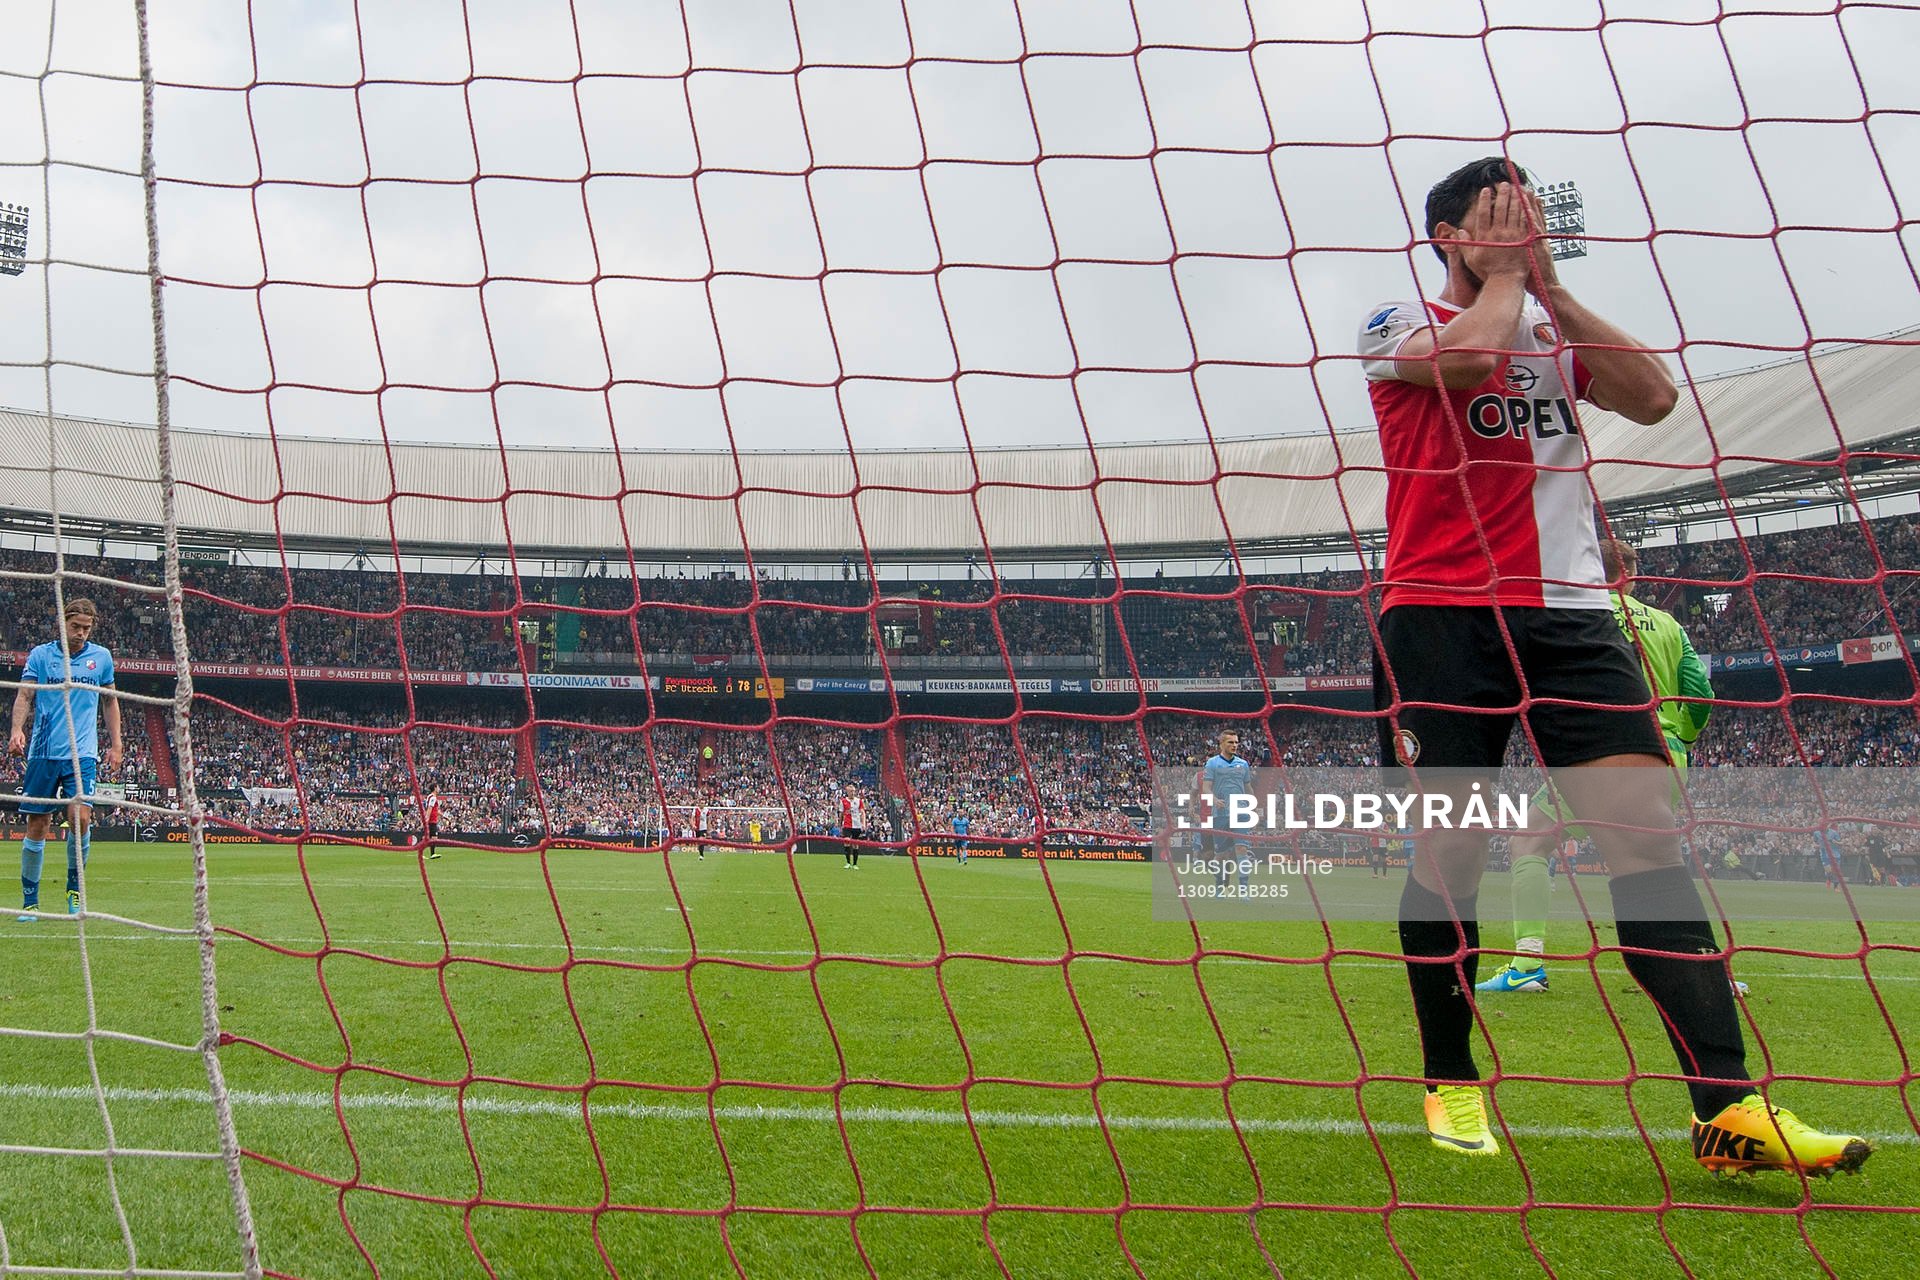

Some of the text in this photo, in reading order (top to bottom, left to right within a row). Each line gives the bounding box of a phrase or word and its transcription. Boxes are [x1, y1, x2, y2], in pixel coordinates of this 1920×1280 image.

[1467, 394, 1580, 439] OPEL
[1778, 652, 1799, 662] epsi
[1813, 649, 1837, 659] pepsi
[120, 661, 154, 670] AMSTEL
[1737, 655, 1760, 666] pepsi
[193, 665, 250, 675] AMSTEL BIER
[300, 668, 321, 678] BIER
[336, 670, 392, 680] AMSTEL BIER
[441, 673, 462, 682] BIER
[489, 673, 510, 685] VLS
[527, 675, 631, 688] CHOONMAAK VLS
[738, 680, 751, 692] 78
[815, 680, 829, 688] Feel
[831, 680, 843, 689] the
[844, 680, 867, 689] Energy
[928, 681, 1050, 691] KEUKENS-BADKAMER-TEGELS
[1105, 680, 1120, 691] HET
[1320, 678, 1373, 688] AMSTEL BIE
[665, 685, 677, 693] FC
[681, 685, 718, 693] Utrecht
[167, 832, 262, 843] OPE Feyenoord.
[1059, 849, 1076, 859] uit,
[1079, 849, 1114, 859] Samen
[1116, 850, 1145, 860] thuis.
